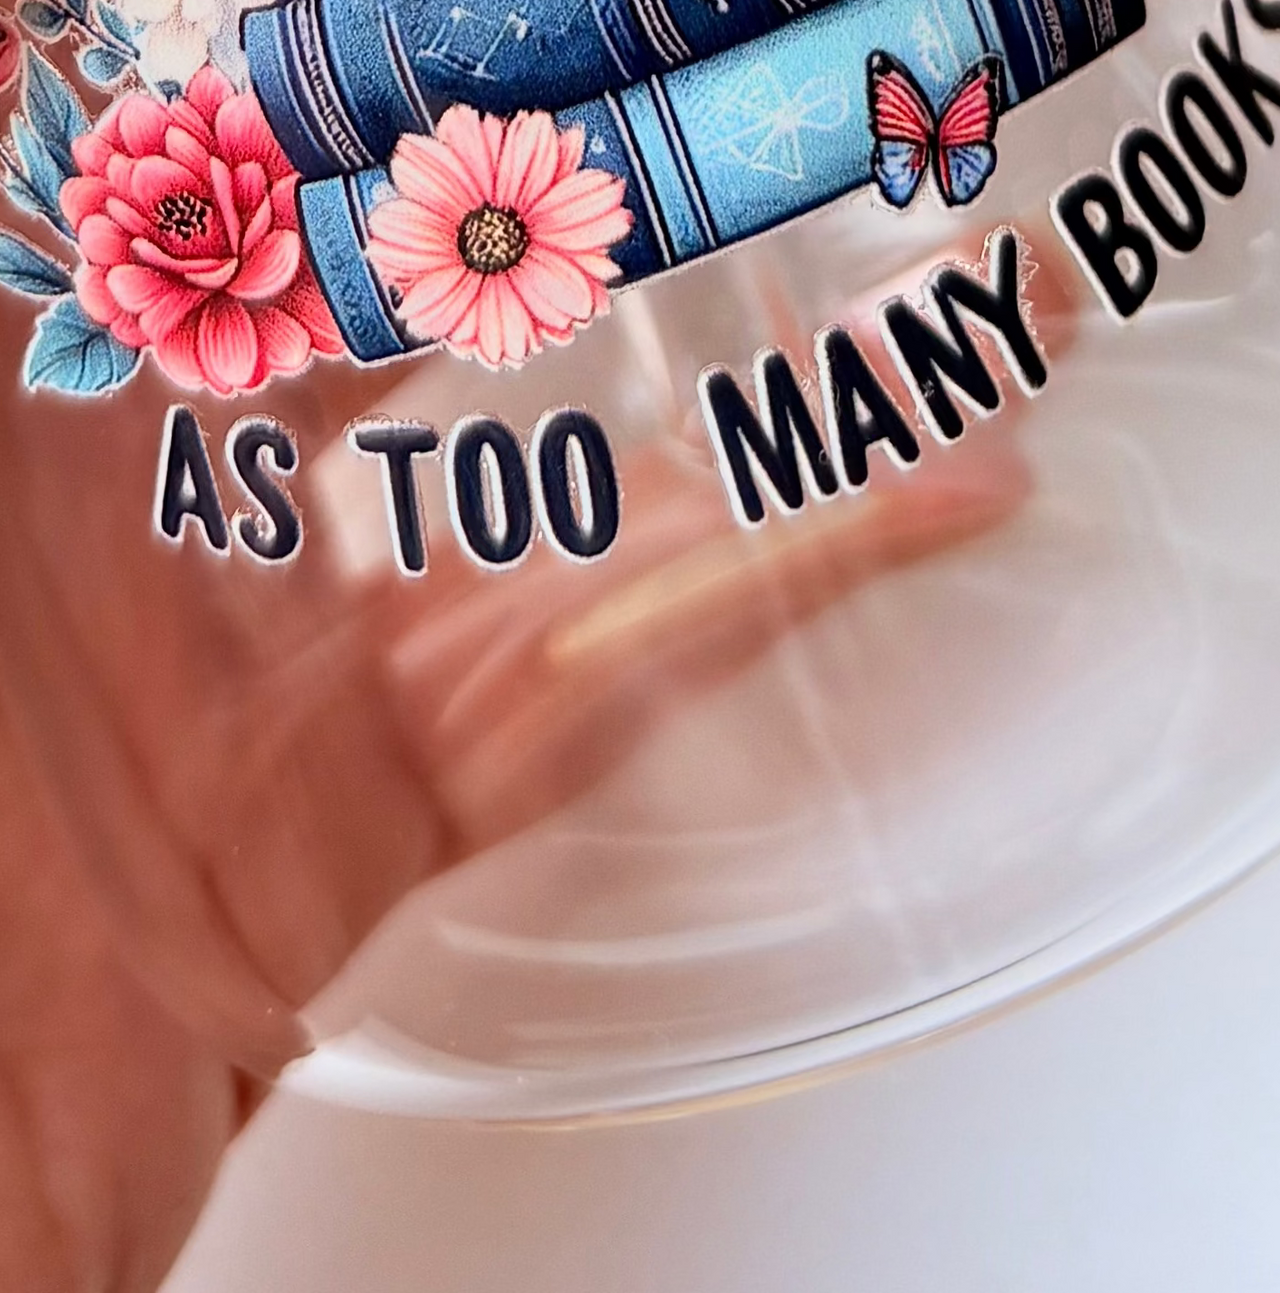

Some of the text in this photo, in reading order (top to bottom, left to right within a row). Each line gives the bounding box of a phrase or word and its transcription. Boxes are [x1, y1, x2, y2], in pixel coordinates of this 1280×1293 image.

[160, 405, 300, 559] AS
[352, 407, 620, 573] TOO
[704, 229, 1048, 523] MANY
